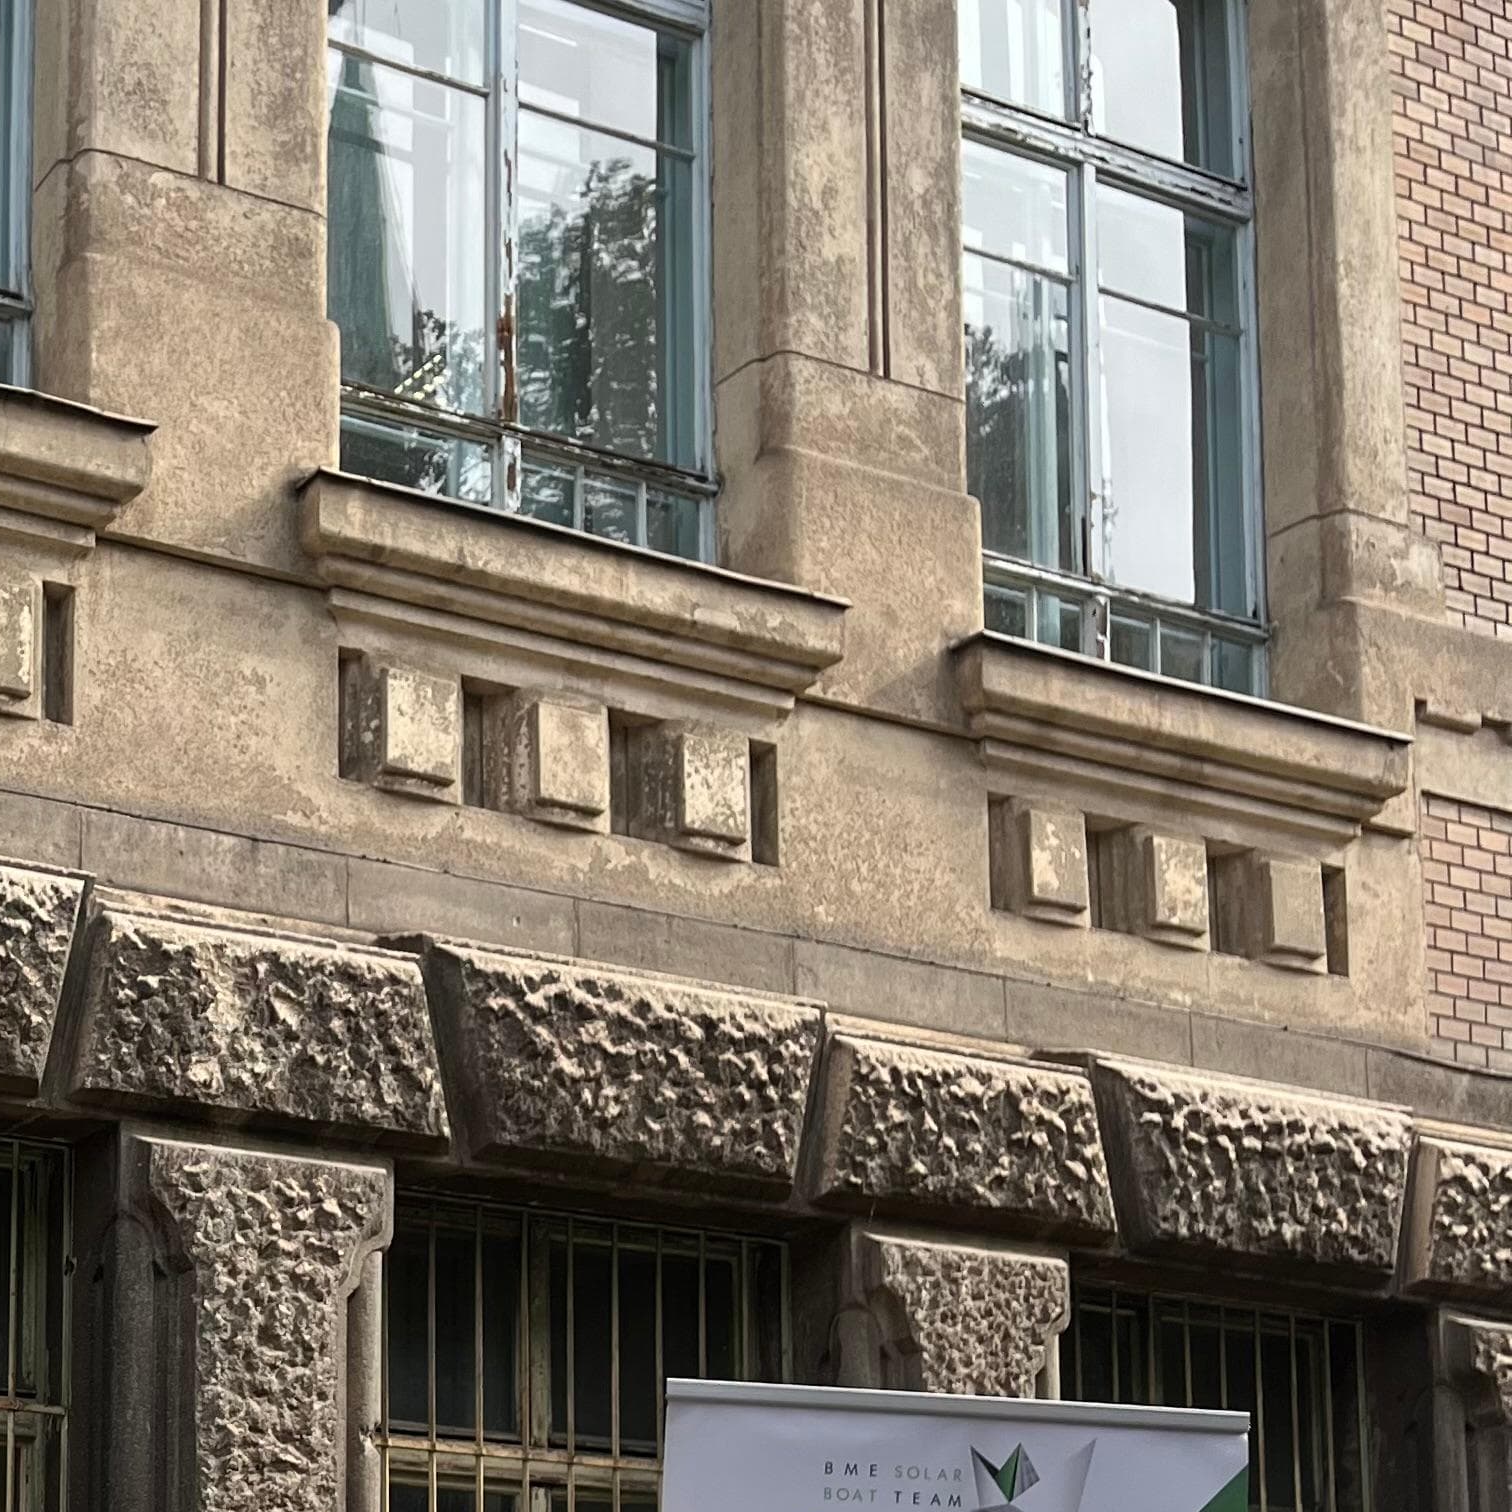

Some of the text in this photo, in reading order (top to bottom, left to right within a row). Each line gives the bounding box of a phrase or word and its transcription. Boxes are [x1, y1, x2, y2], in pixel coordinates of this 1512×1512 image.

[824, 1461, 963, 1482] BME SOLAR
[823, 1486, 963, 1508] BOAT TEAM
